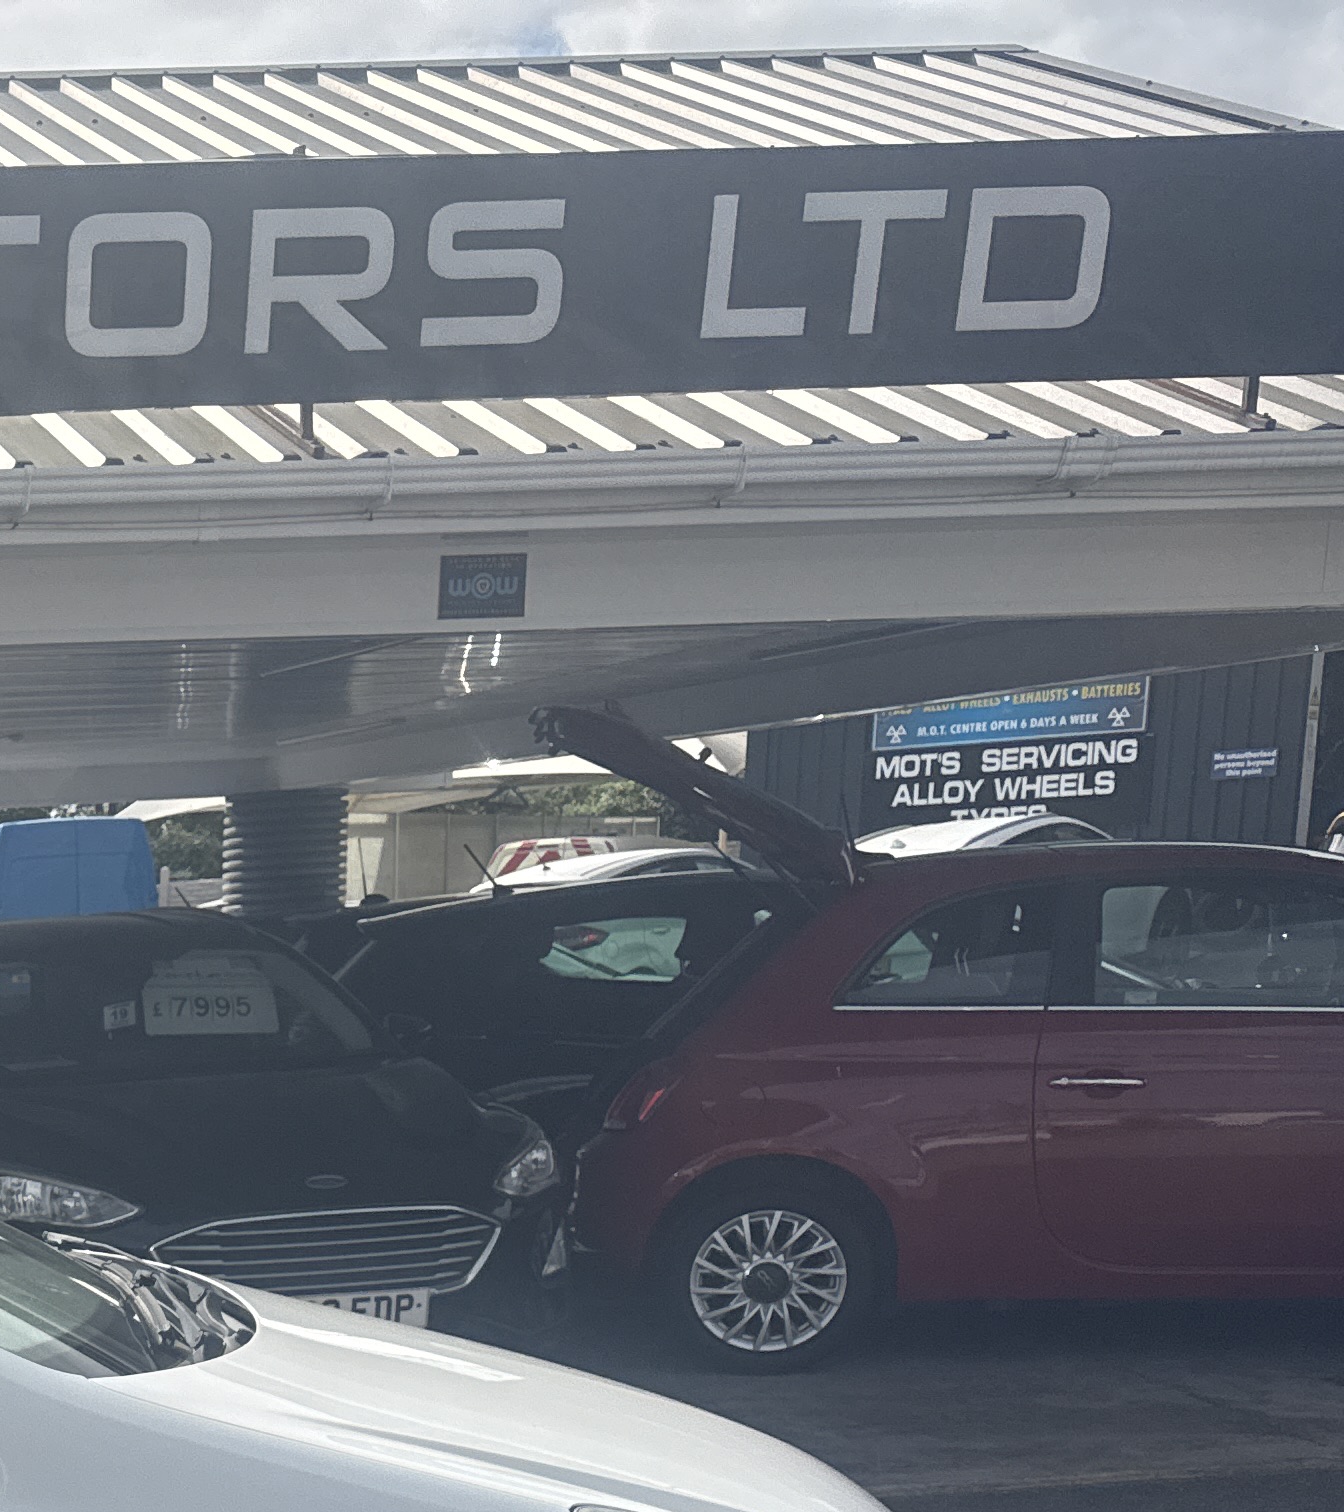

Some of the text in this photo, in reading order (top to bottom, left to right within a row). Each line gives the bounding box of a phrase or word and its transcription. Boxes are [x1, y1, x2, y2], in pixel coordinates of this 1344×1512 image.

[700, 185, 1111, 339] LTD
[1013, 688, 1069, 705] EXHAUSTS
[1081, 681, 1141, 699] BATTERIES
[917, 713, 1099, 737] M.O.T. CENTRE OPEN 6 DAYS A WEEK
[875, 739, 1138, 780] MOT'S SERVICING
[891, 771, 1116, 807] ALLOY WHEELS
